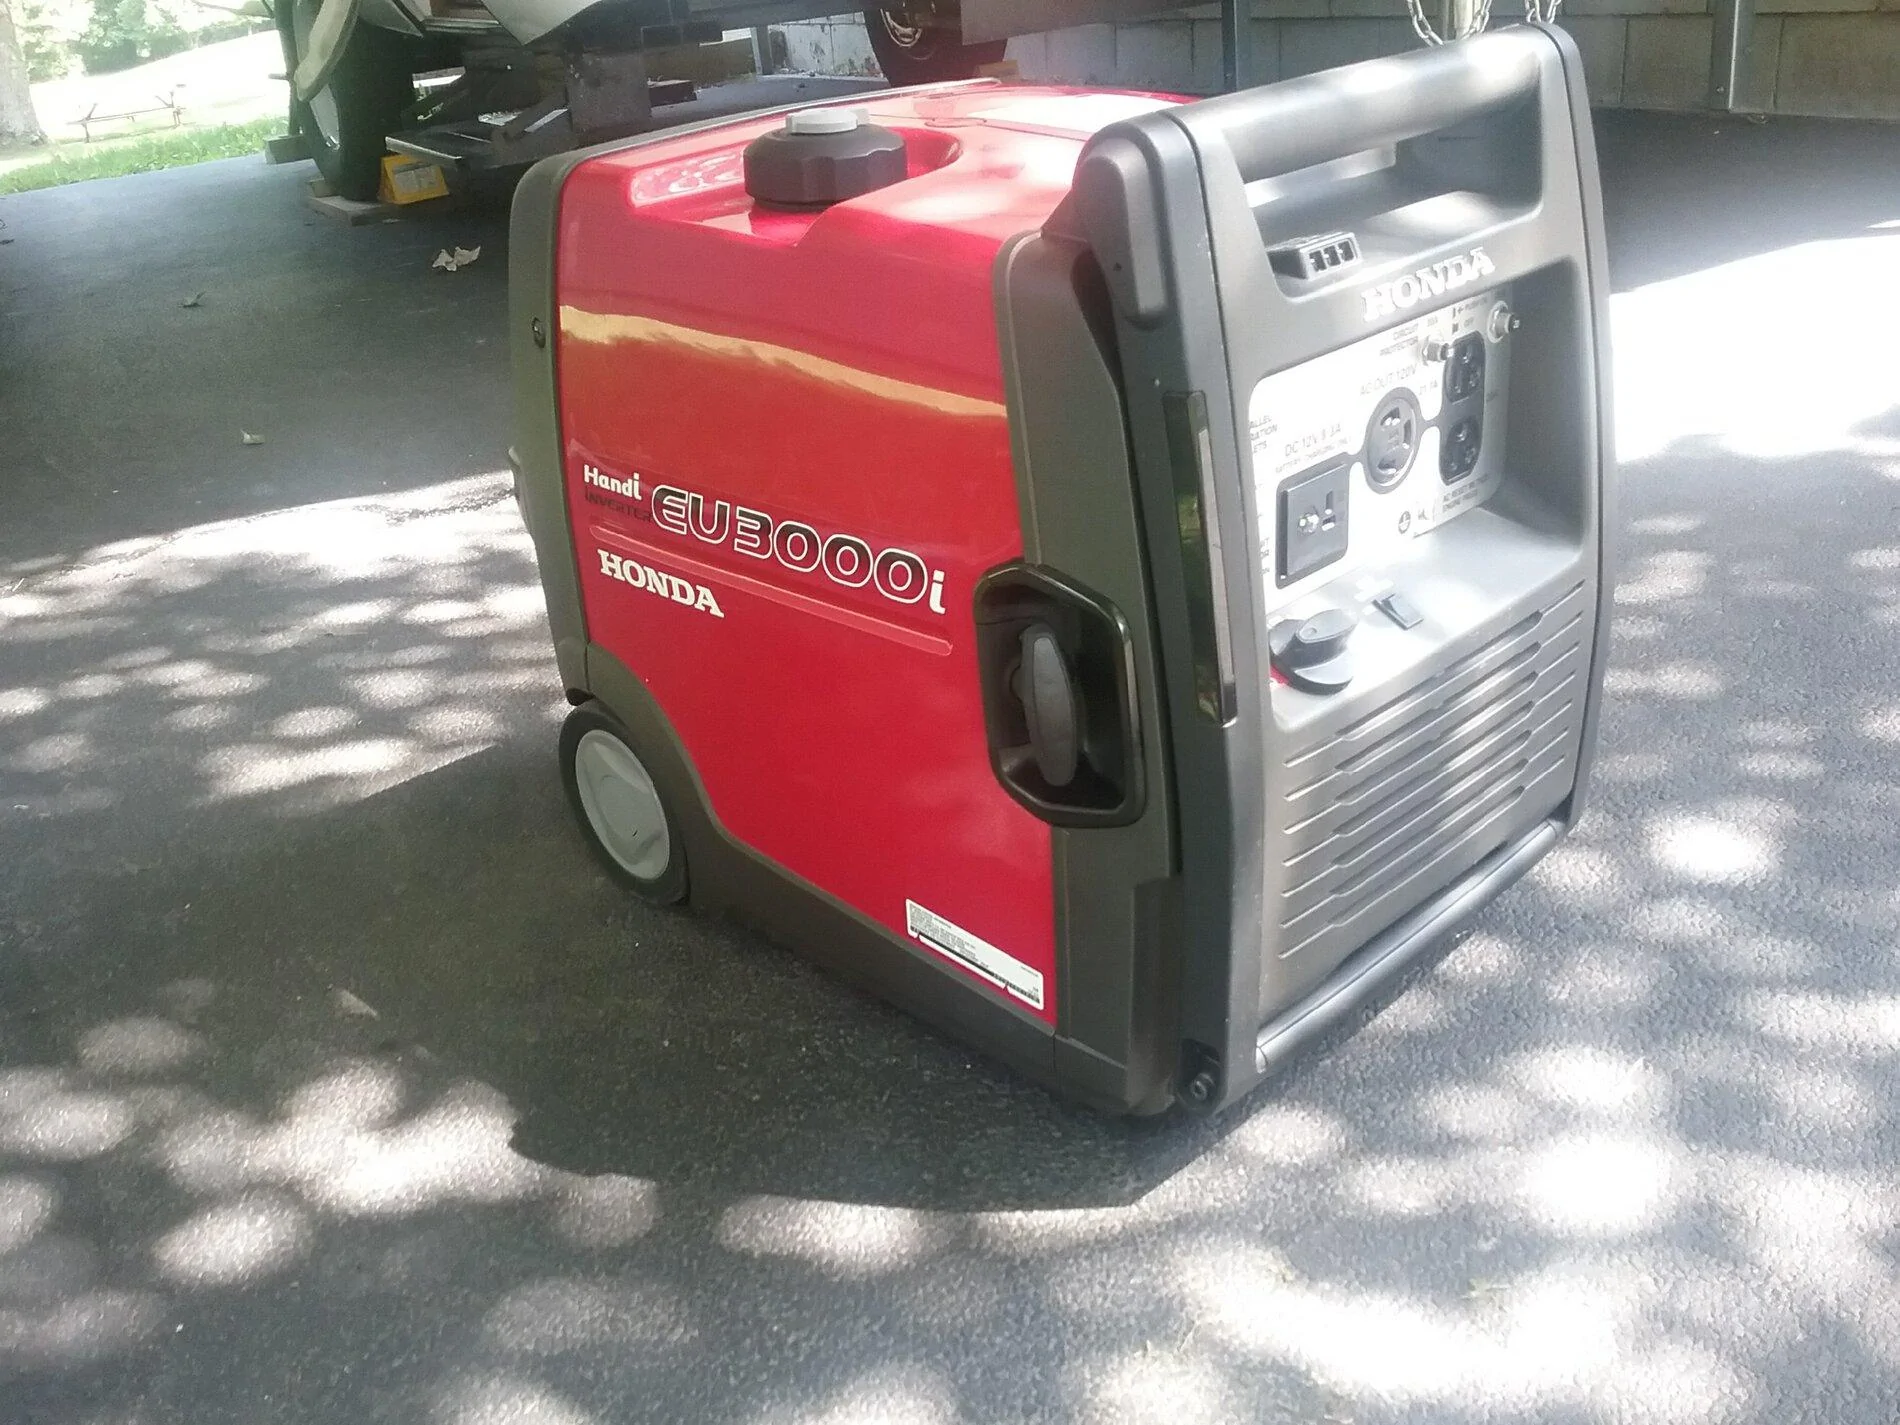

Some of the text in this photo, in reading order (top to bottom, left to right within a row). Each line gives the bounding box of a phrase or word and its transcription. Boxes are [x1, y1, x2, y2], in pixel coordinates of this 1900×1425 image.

[1360, 246, 1496, 322] HONDA
[584, 464, 642, 501] Handi
[1285, 440, 1300, 457] DC
[597, 548, 725, 618] HONDA
[651, 484, 946, 615] EU3000i
